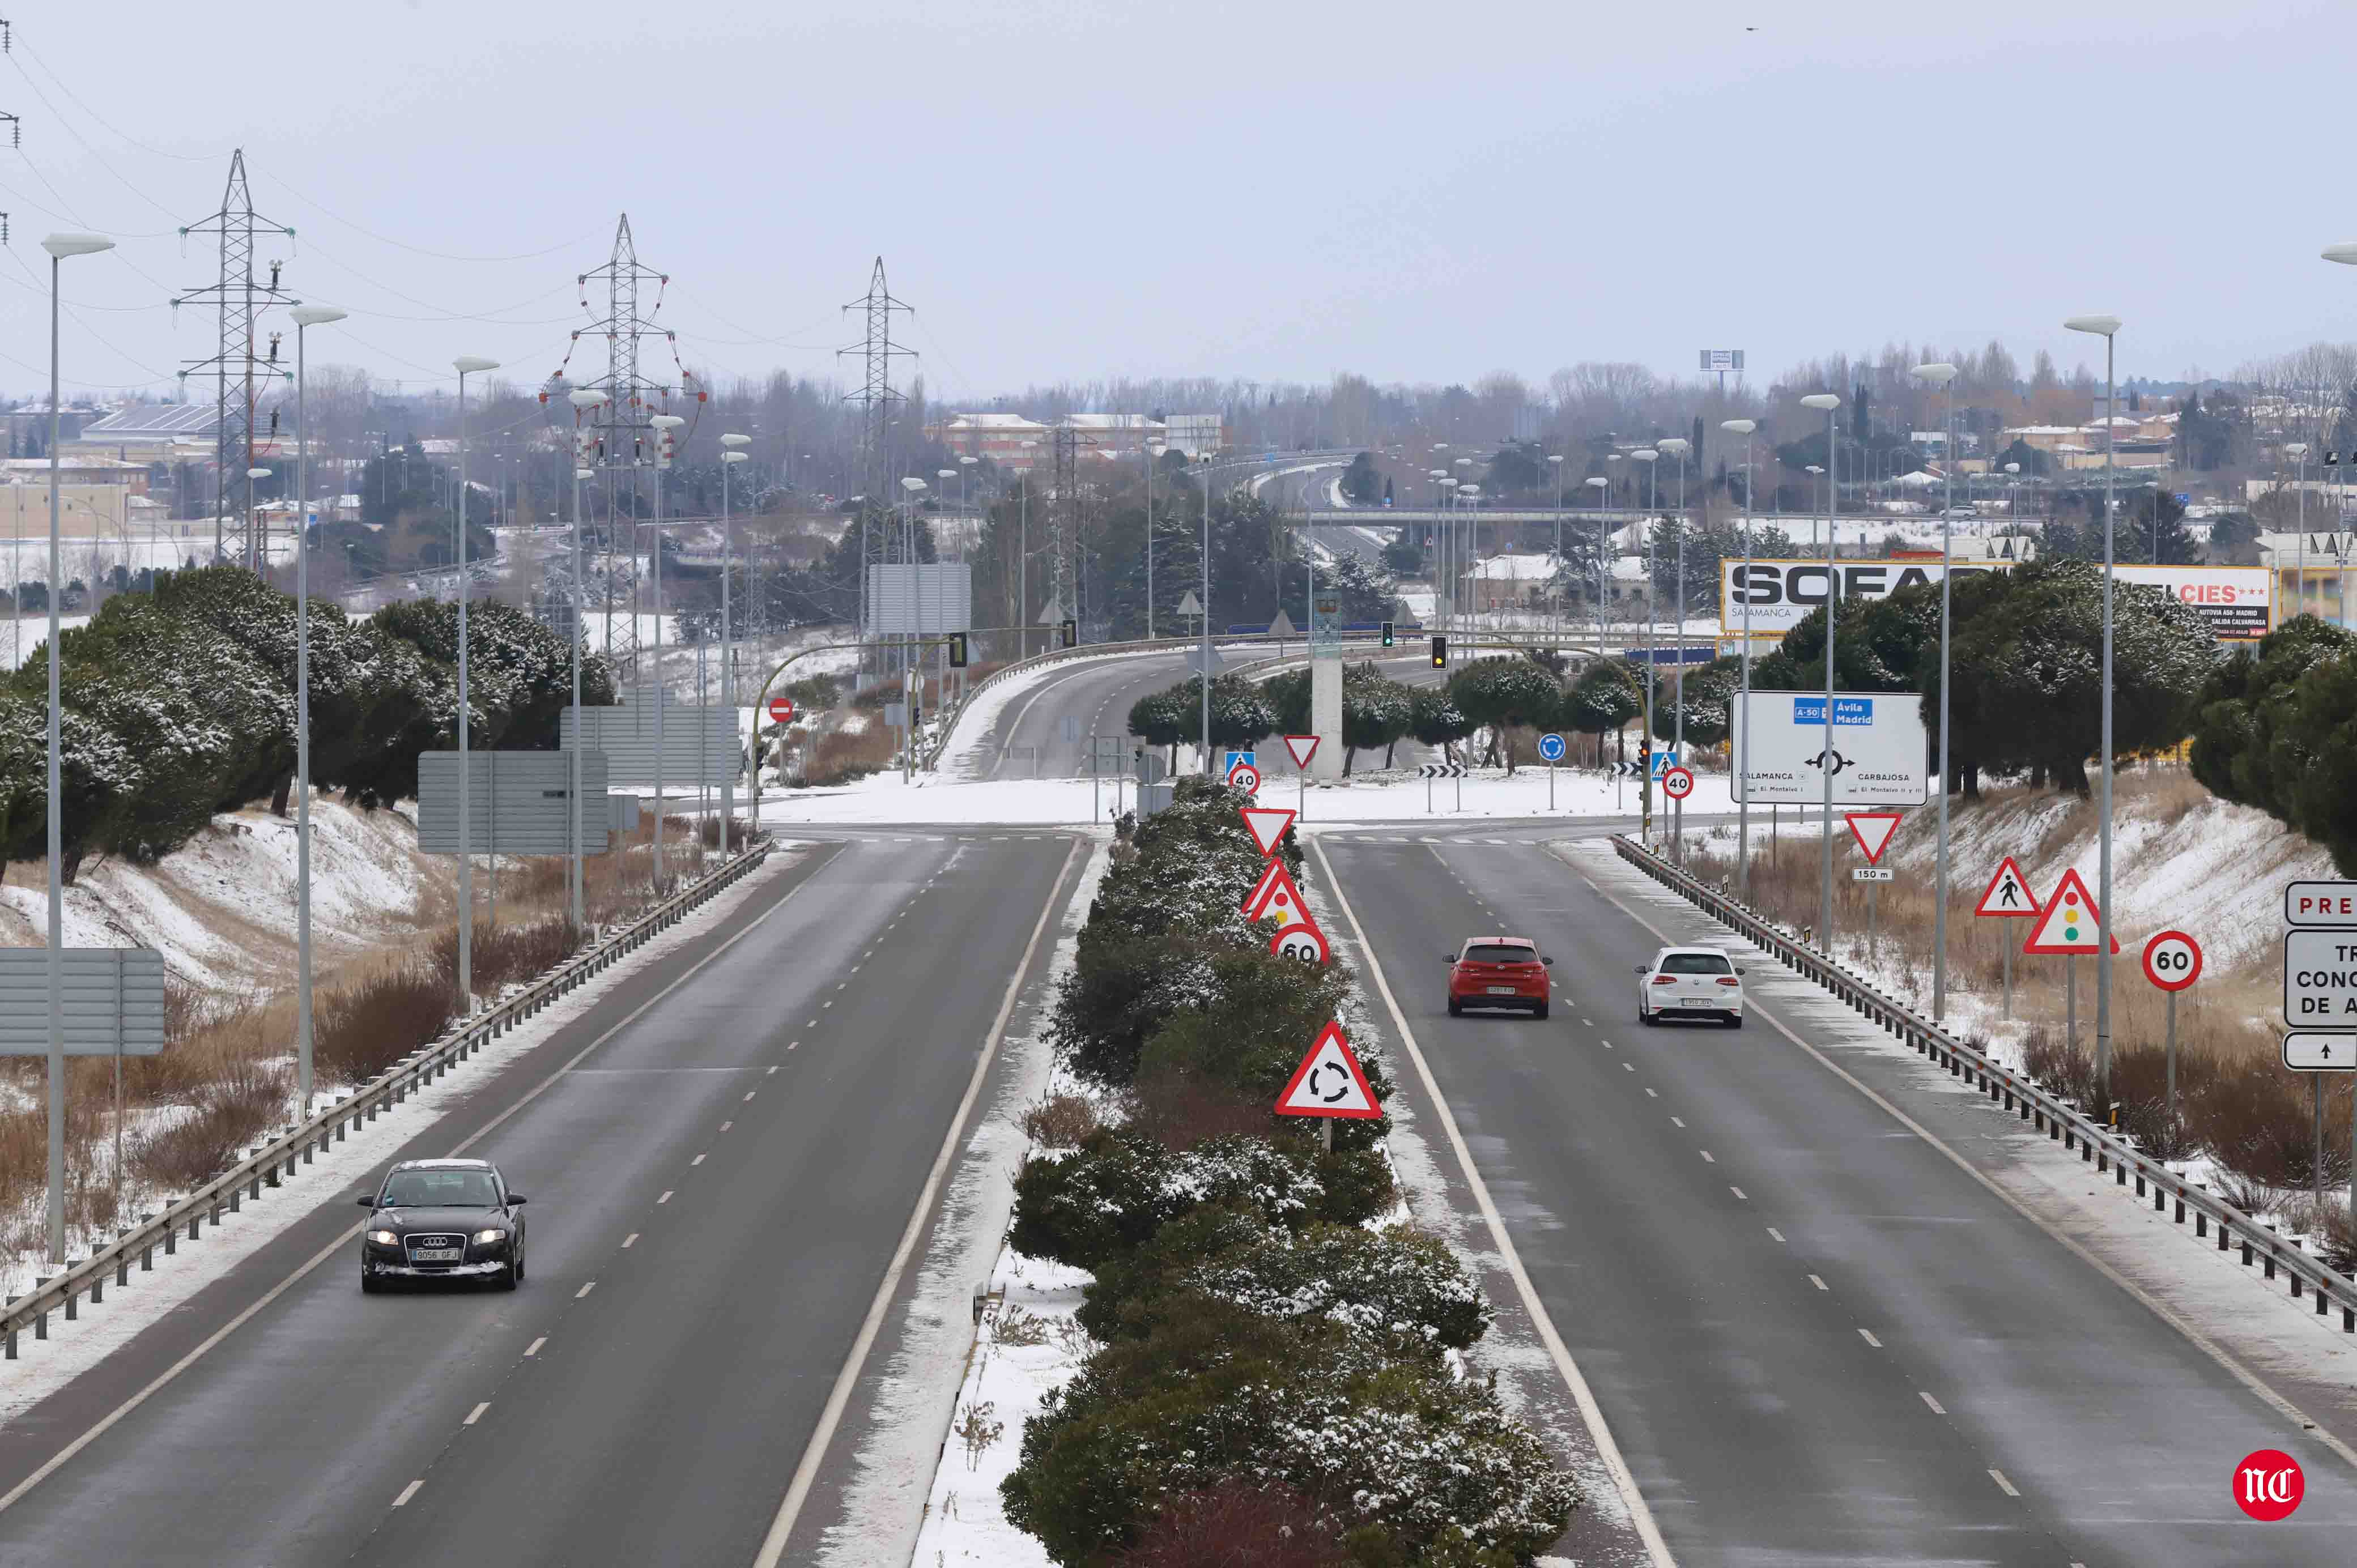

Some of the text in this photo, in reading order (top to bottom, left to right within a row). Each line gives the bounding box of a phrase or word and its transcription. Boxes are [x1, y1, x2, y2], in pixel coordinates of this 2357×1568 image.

[2180, 585, 2236, 603] CIES
[1731, 608, 1791, 617] SAAMANCA
[1836, 715, 1872, 724] Madrid
[1236, 775, 1254, 785] 40
[1669, 778, 1687, 789] 40
[1283, 943, 1315, 961] 60
[2157, 952, 2188, 970] 60
[2301, 997, 2330, 1014] DE
